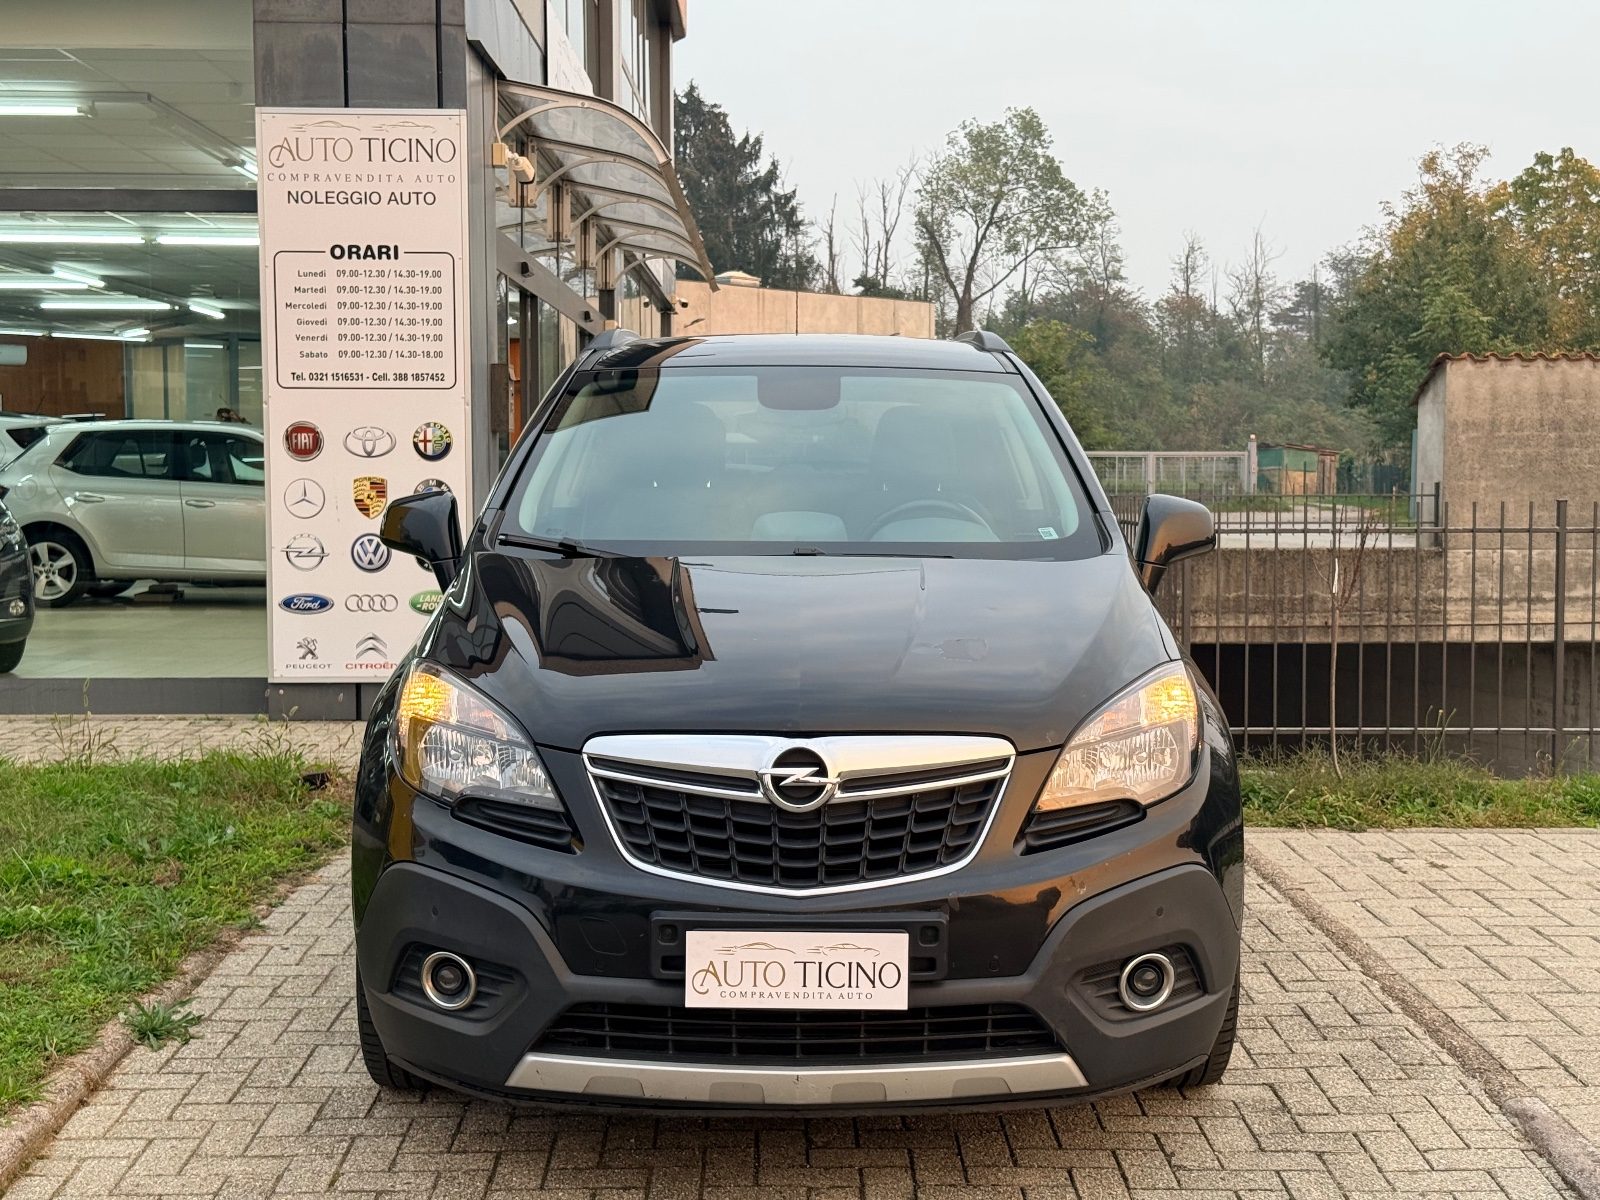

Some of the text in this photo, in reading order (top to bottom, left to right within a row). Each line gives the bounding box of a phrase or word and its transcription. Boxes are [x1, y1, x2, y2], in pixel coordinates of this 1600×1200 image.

[268, 136, 457, 169] AUTO TICINO
[267, 172, 456, 184] COMPRAVENDITA AUTO
[287, 190, 437, 206] NOLEGGIO AUTO
[329, 244, 400, 261] ORARI
[336, 269, 386, 278] 09.00-12.30
[393, 269, 442, 279] 14.30-19.00
[336, 285, 386, 294] 09.00-12.30
[394, 285, 443, 295] 14.30-19.00
[337, 301, 386, 310] 09.00-12.30
[394, 301, 443, 311] 14.30-19.00
[337, 317, 387, 326] 09.00-12.30
[394, 317, 443, 327] 14.30-19.00
[337, 333, 387, 342] 09.00-12.30
[395, 333, 443, 342] 14.30-19.00
[299, 350, 328, 358] Sabato
[338, 350, 387, 359] 09.00-12.30
[395, 350, 444, 359] 14.30-18.00
[290, 372, 306, 381] Tel.
[308, 372, 329, 382] 0321
[331, 372, 364, 382] 1516531
[371, 372, 391, 382] Cell.
[392, 372, 409, 382] 388
[411, 372, 446, 382] 1857452
[291, 432, 314, 450] FIAT
[417, 479, 450, 492] BMW
[290, 597, 321, 610] Ford
[691, 960, 902, 995] AUTO TICINO
[720, 990, 874, 1000] COMPRAVENDITA AUTO
